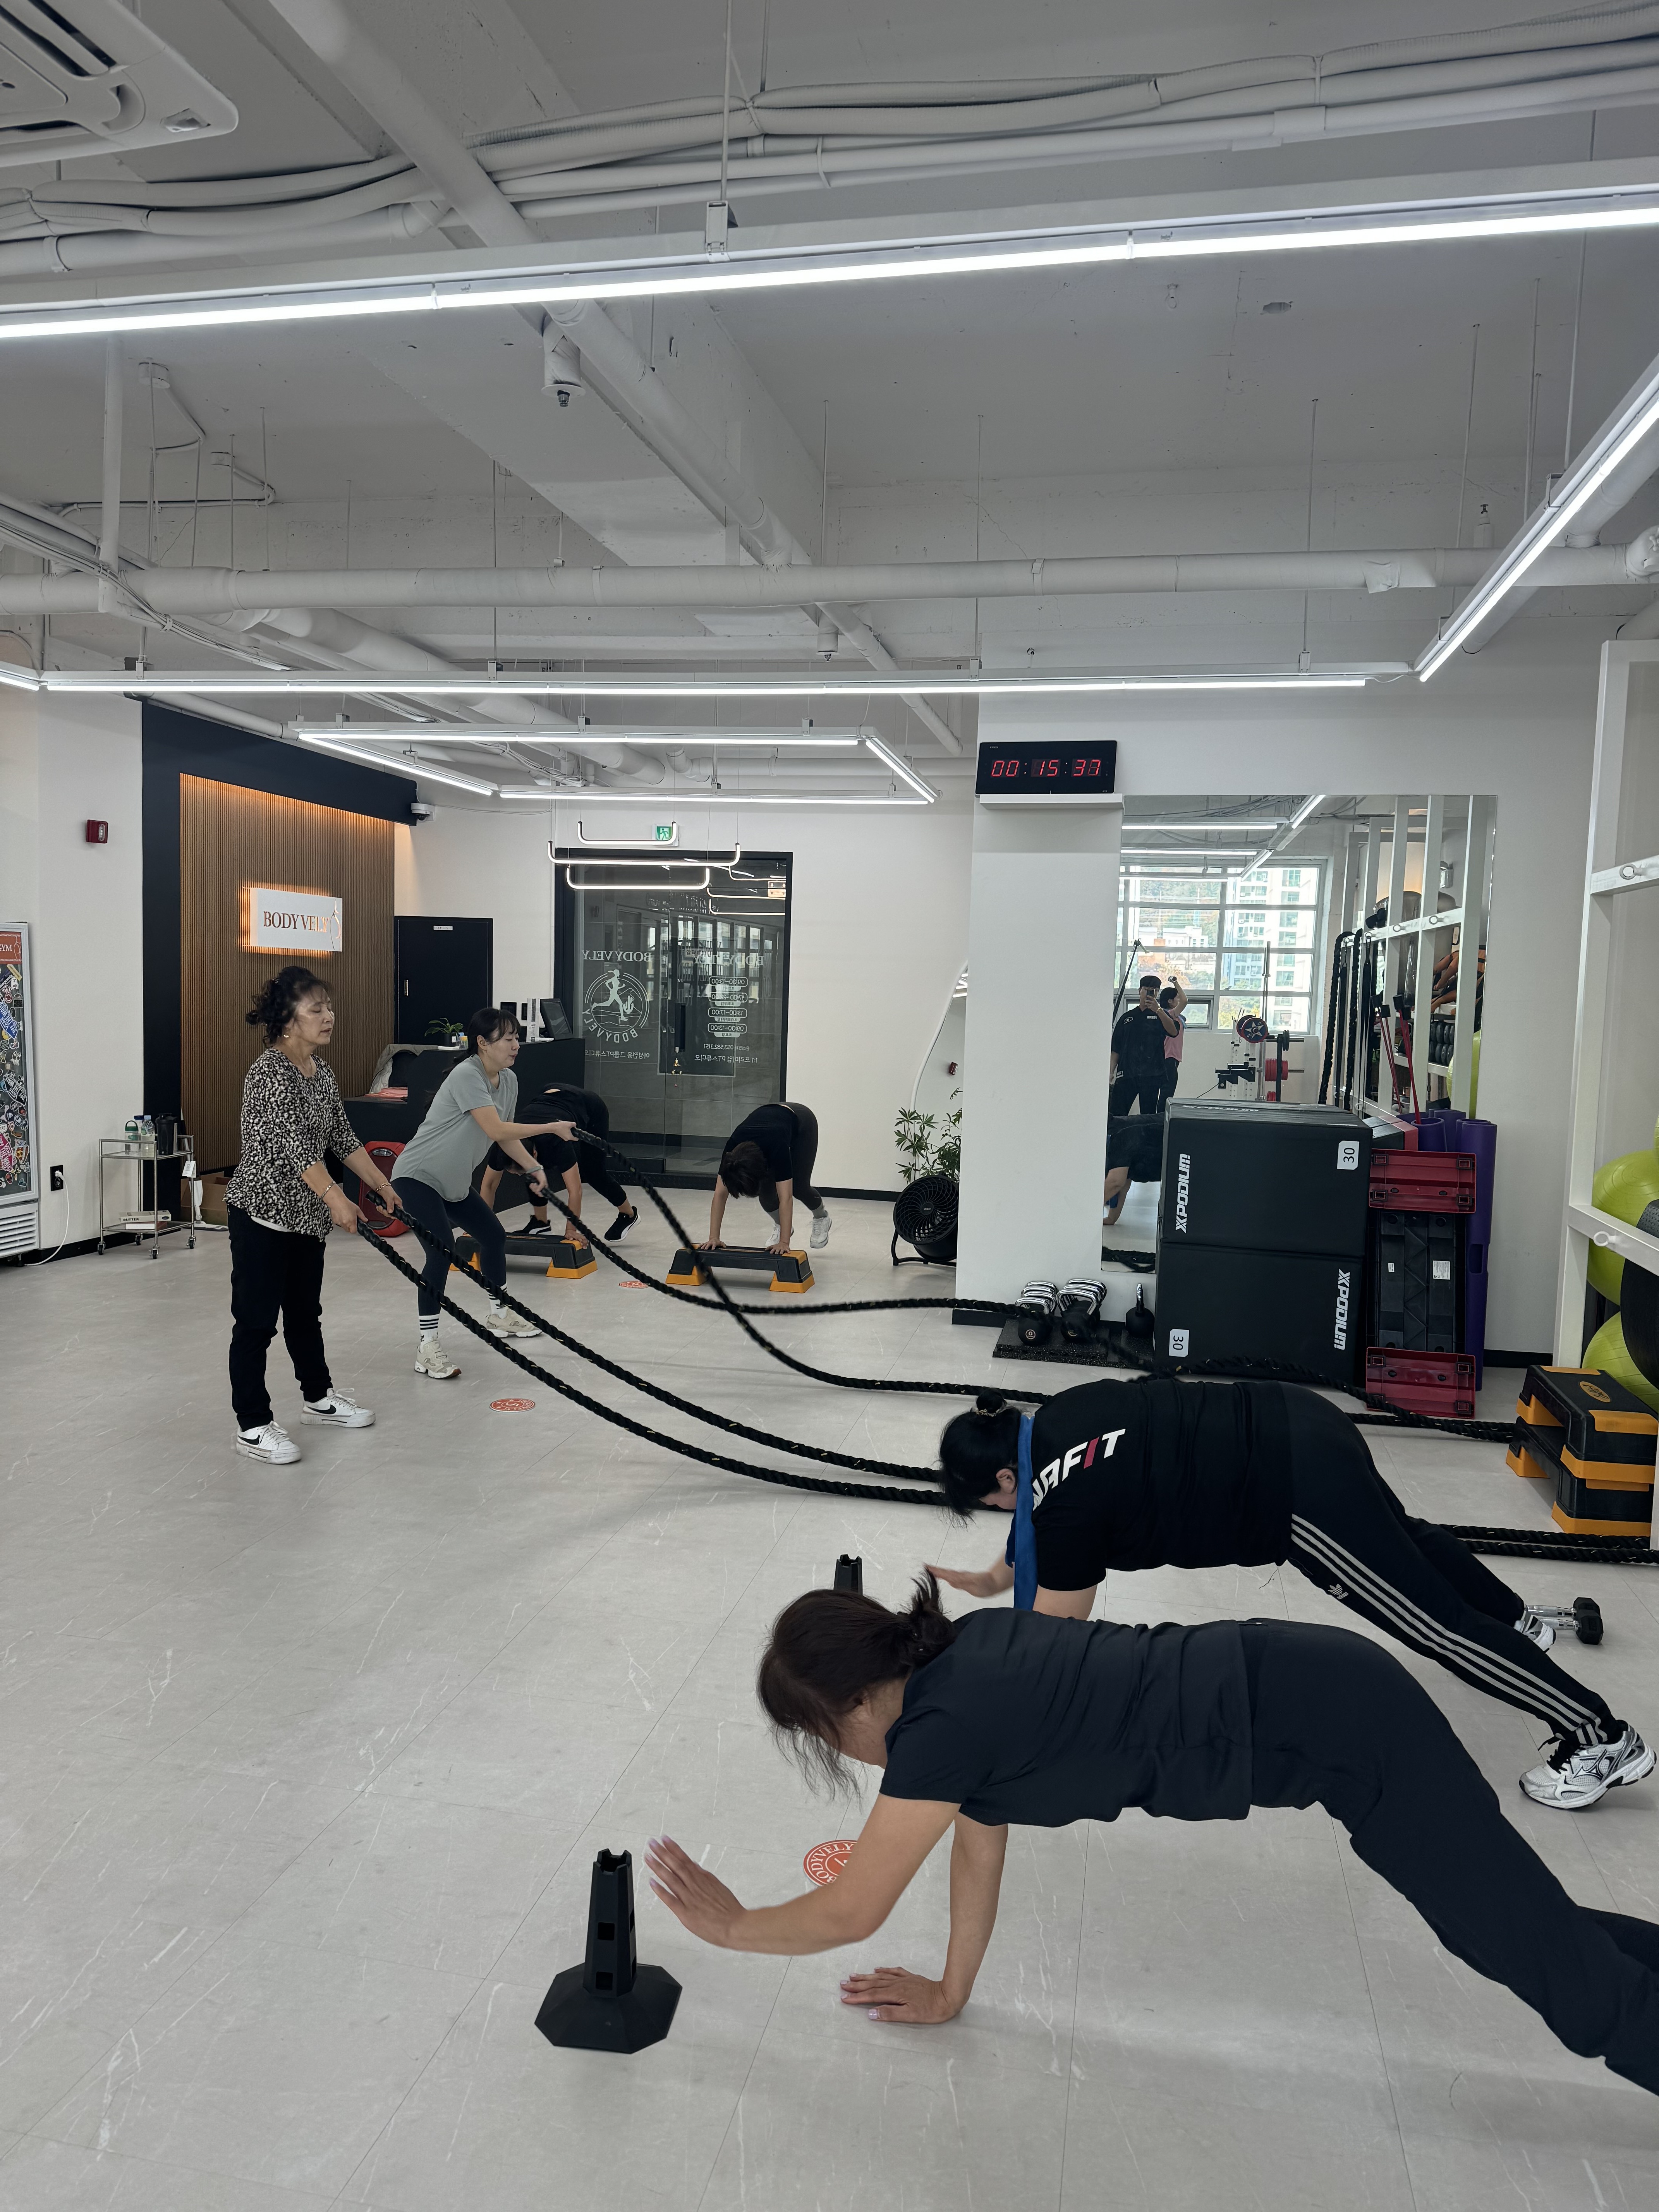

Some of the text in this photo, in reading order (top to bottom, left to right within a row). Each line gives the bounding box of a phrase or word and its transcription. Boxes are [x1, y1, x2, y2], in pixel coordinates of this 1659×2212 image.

[1343, 1147, 1355, 1163] 30
[1175, 1153, 1190, 1233] XPODIUM
[1334, 1269, 1350, 1350] XPODIUM
[1173, 1335, 1183, 1350] 30
